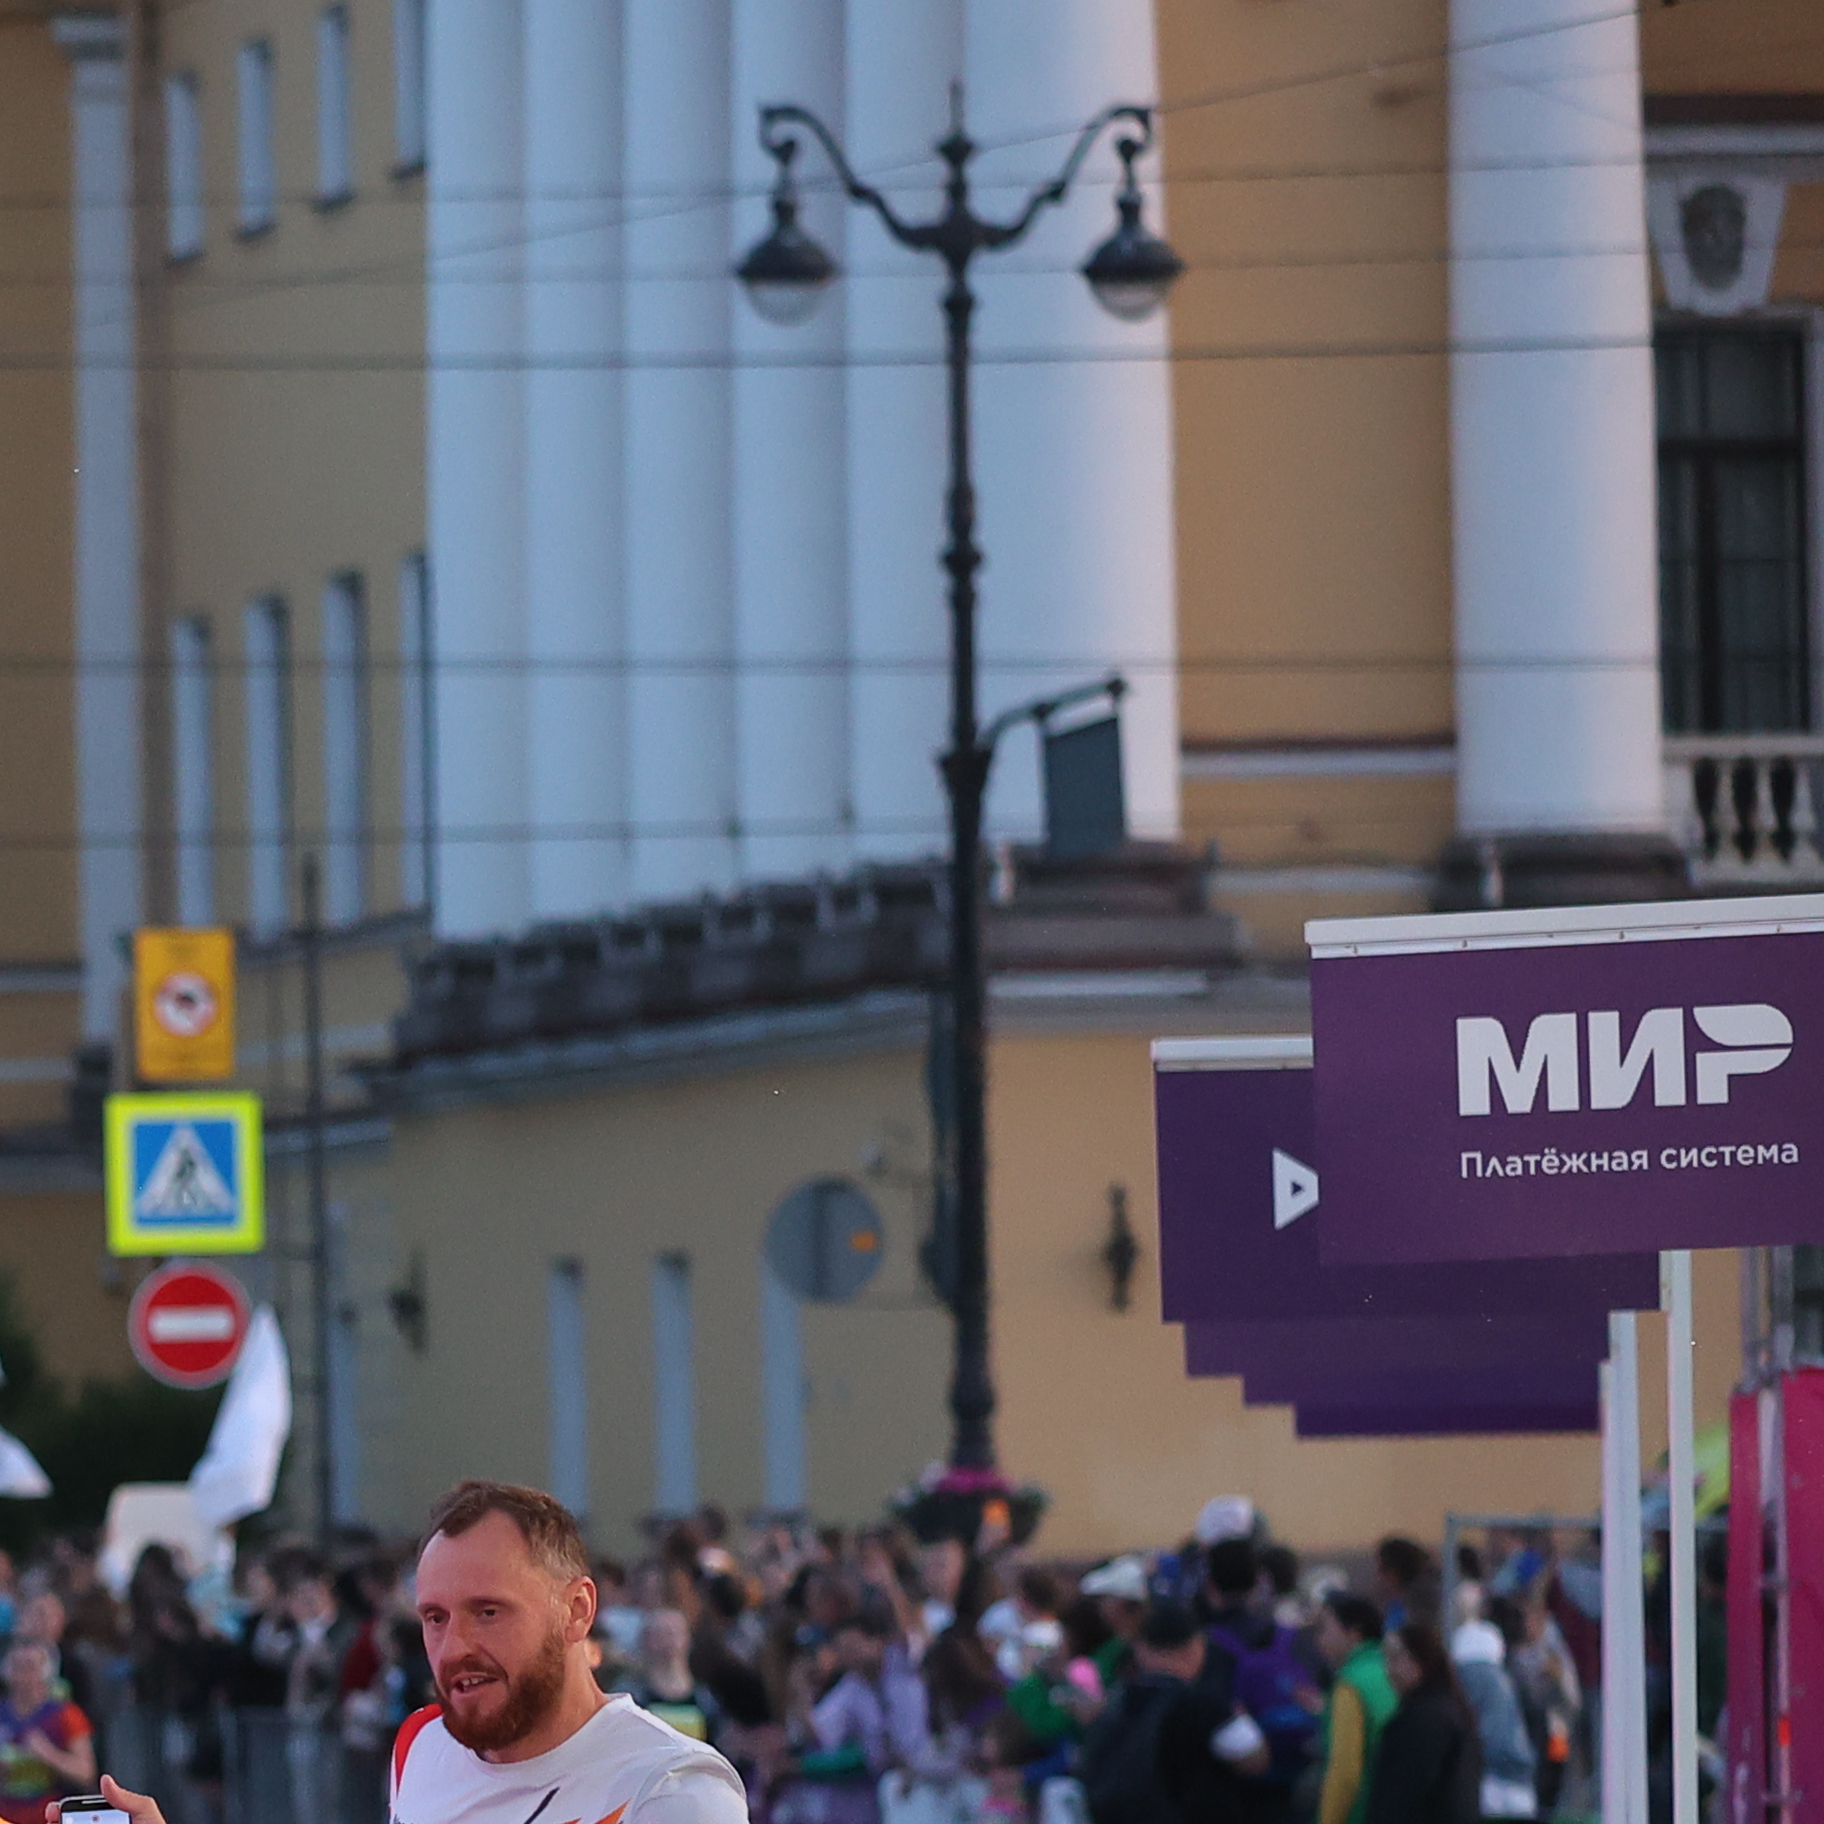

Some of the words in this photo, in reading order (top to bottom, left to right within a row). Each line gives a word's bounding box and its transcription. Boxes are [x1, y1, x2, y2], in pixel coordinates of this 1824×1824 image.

[1456, 1003, 1794, 1116] МИР
[1460, 1148, 1649, 1178] Платёжная
[1660, 1142, 1799, 1170] система
